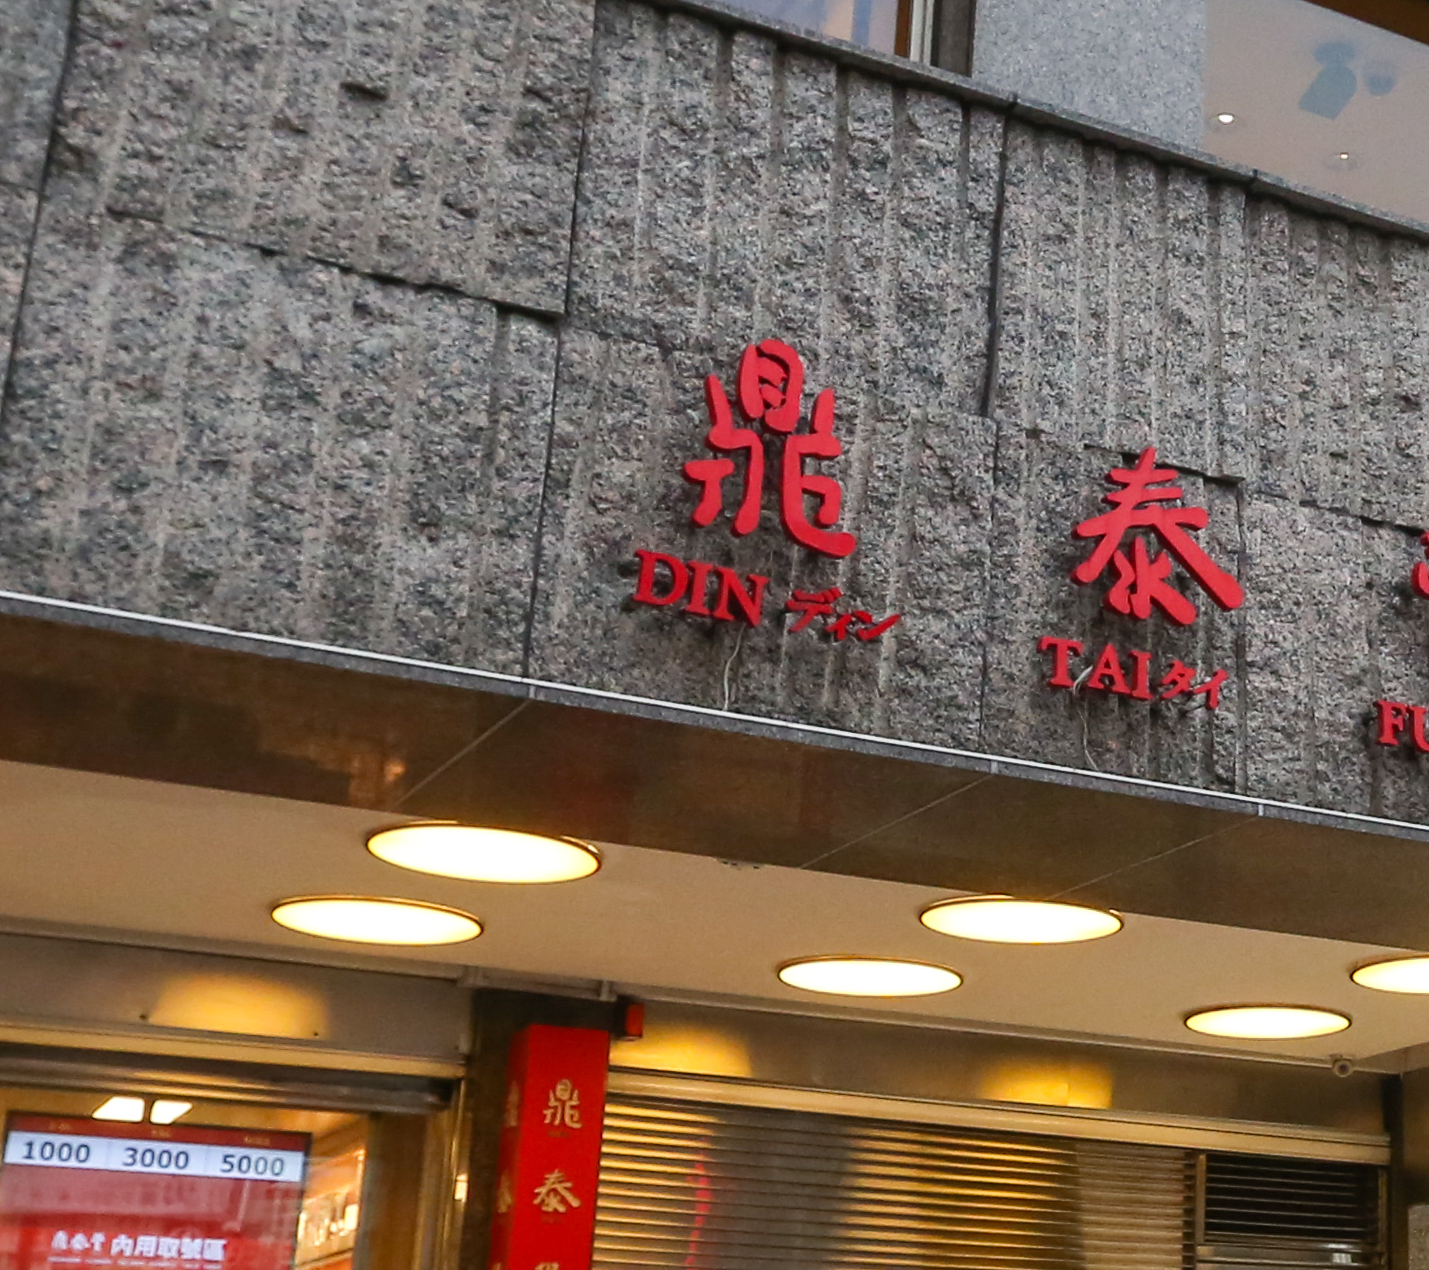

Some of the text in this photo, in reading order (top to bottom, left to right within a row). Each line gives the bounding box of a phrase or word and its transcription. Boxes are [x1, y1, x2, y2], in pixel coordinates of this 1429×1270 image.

[631, 548, 770, 628] DIN
[1037, 636, 1154, 701] TAI
[1160, 659, 1229, 710] タイ
[22, 1140, 286, 1177] 1000 3000 5000
